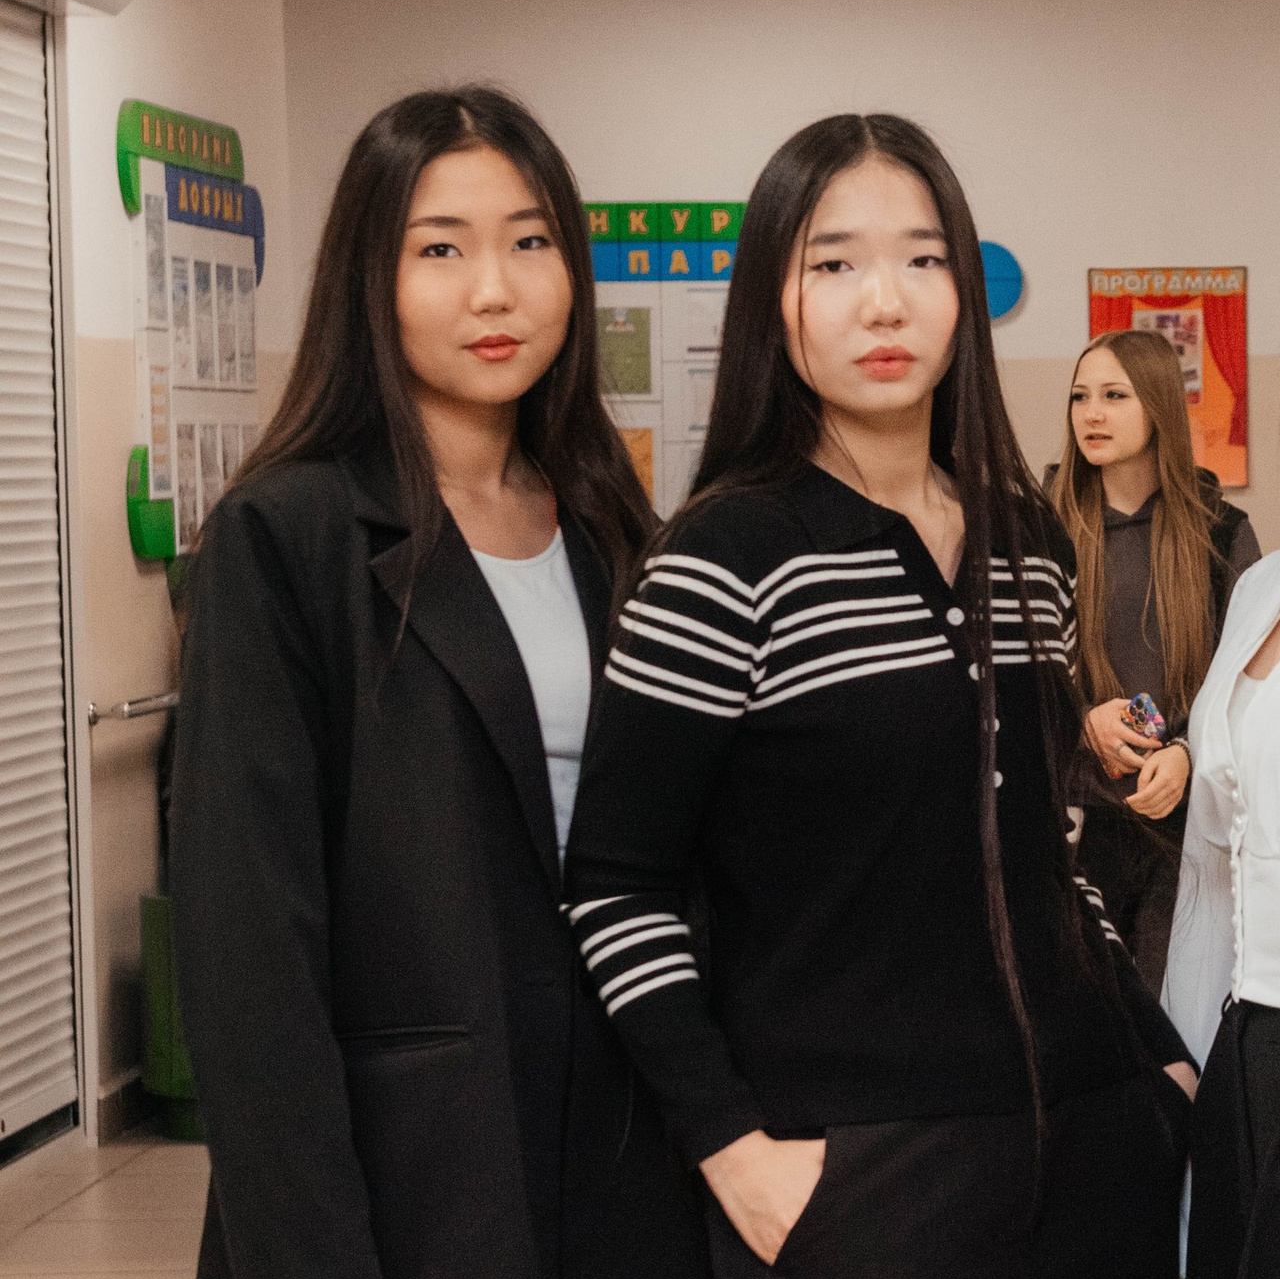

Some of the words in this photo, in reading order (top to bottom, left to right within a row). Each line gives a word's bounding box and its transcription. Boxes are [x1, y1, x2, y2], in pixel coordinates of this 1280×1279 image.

[142, 112, 231, 167] ПАНОРАМА
[178, 178, 243, 223] ДОБРЫХ
[1091, 273, 1242, 292] ПРОГРАММА
